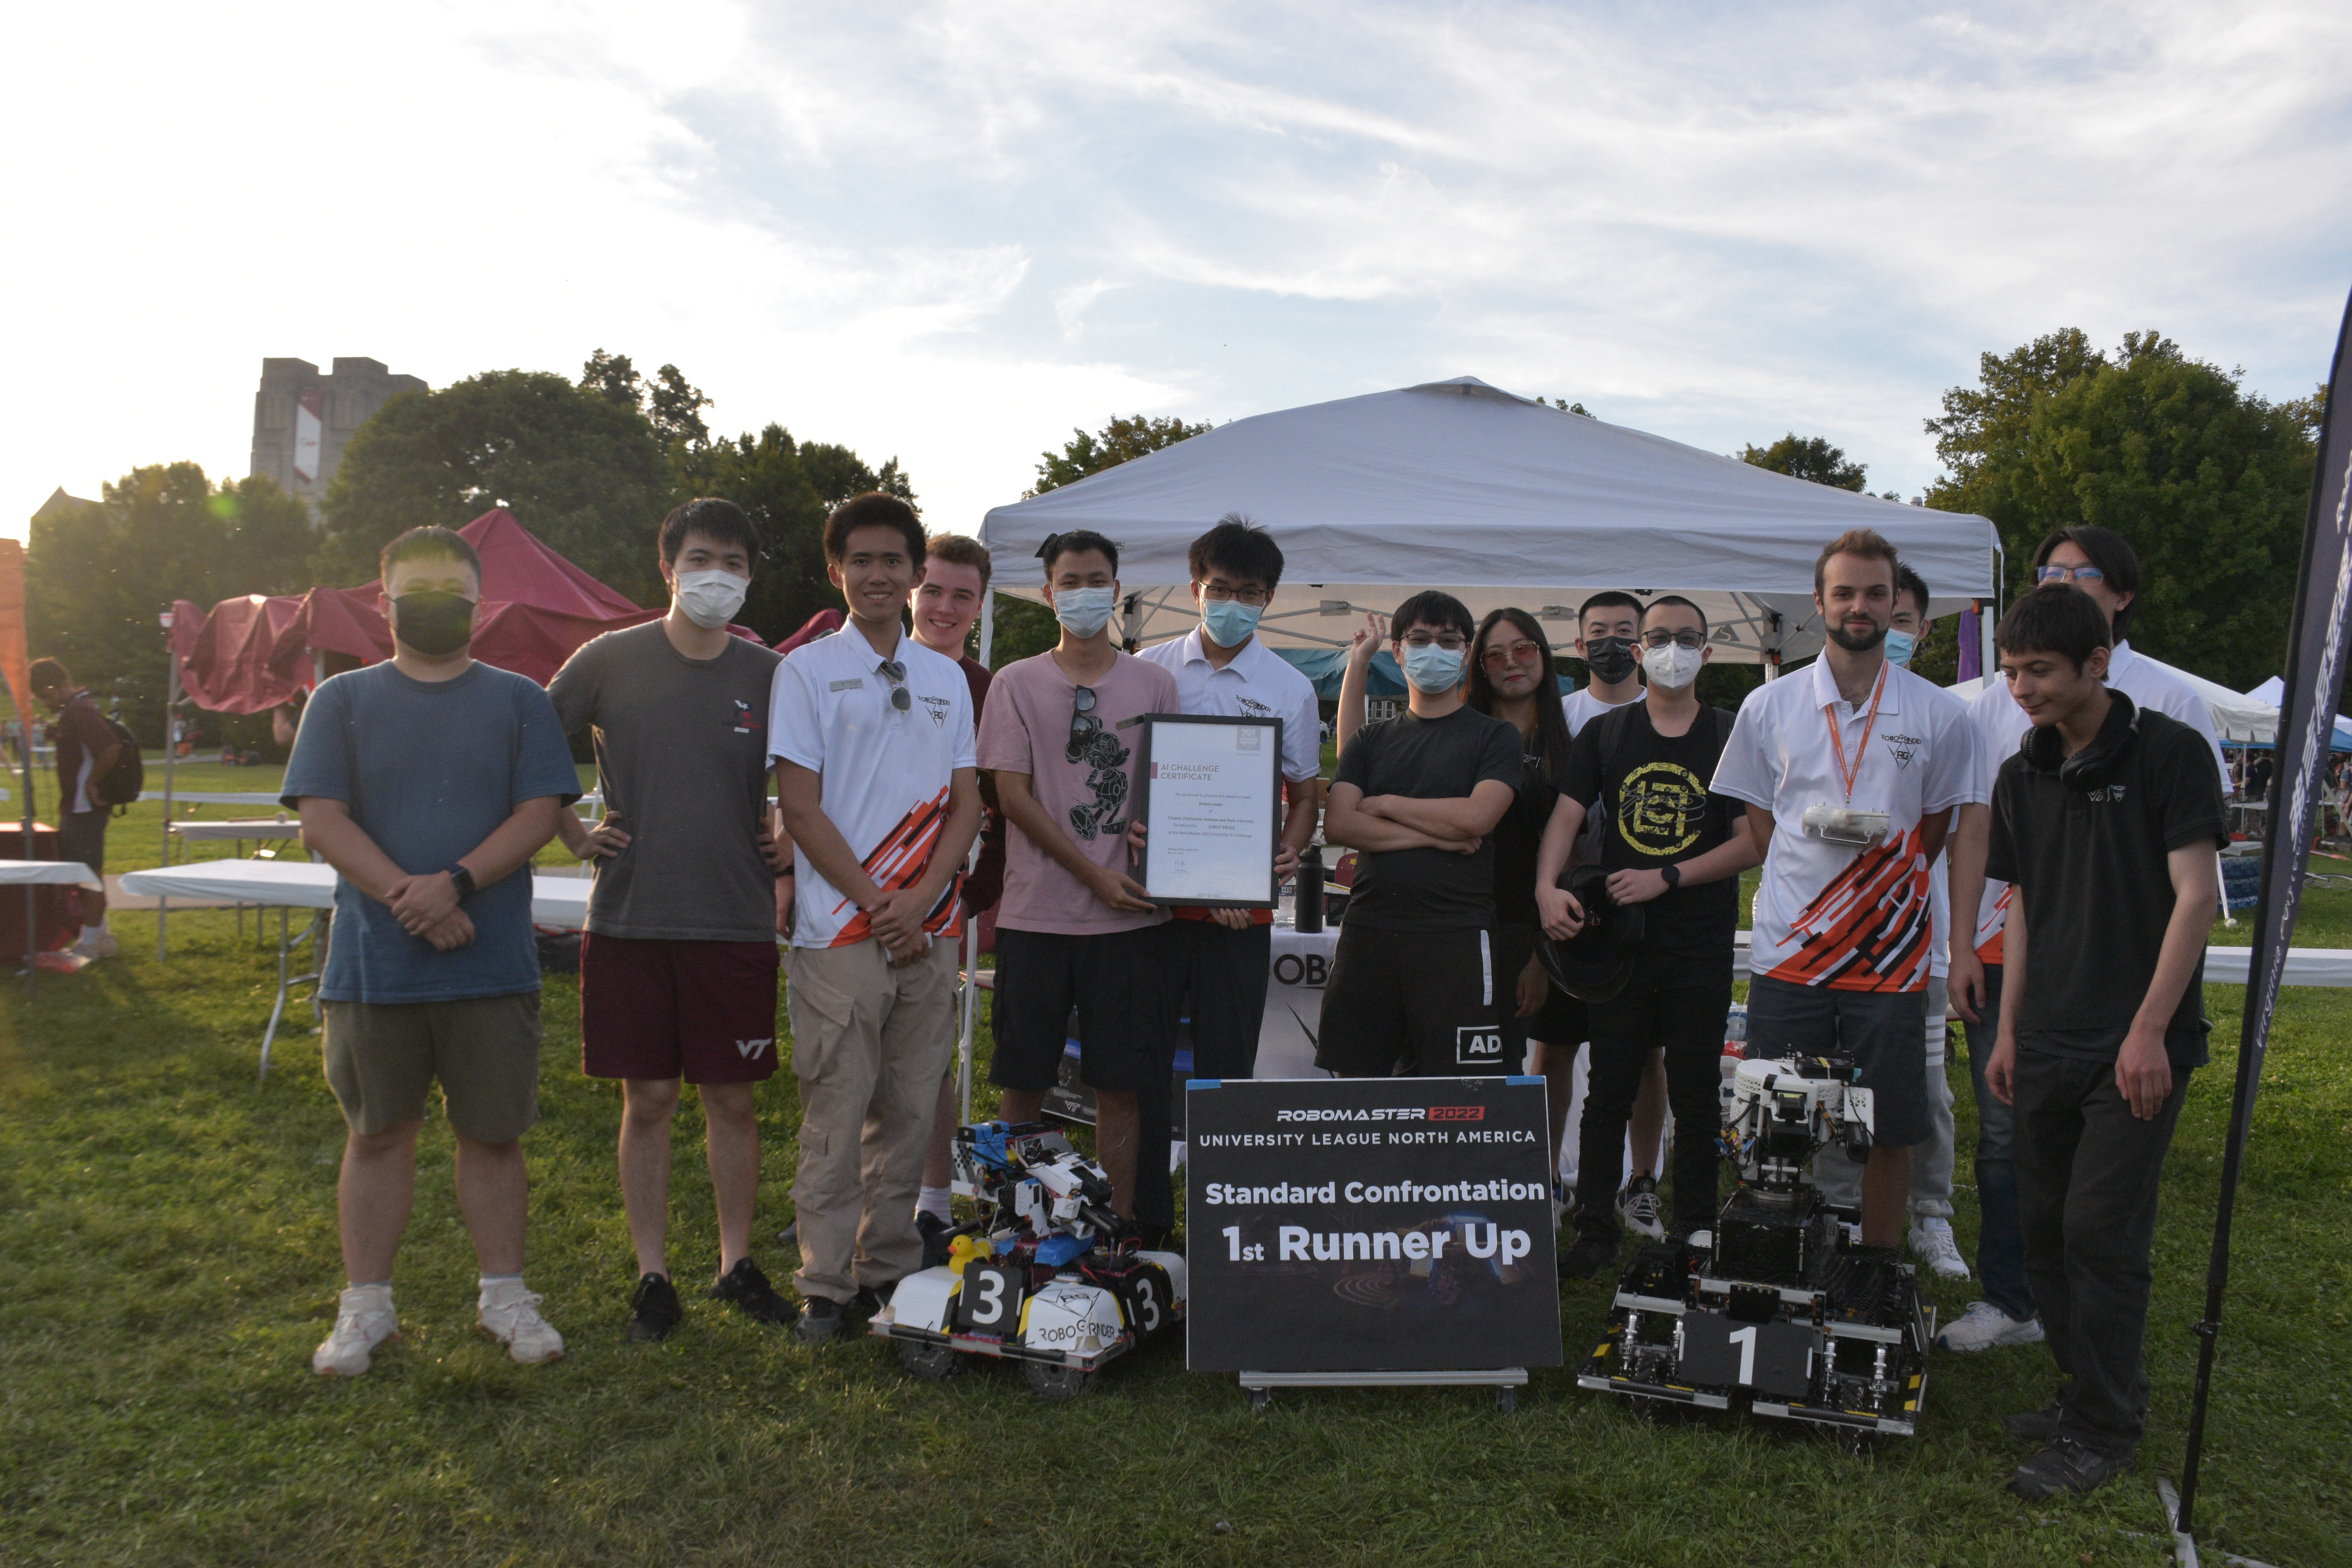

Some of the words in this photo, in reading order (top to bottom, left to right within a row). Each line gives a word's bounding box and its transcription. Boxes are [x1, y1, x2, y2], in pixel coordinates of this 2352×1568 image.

[735, 1037, 772, 1060] VT
[1277, 1108, 1425, 1122] ROBOMASTER
[1433, 1107, 1480, 1120] 2022
[1200, 1134, 1305, 1147] UNIVERSITY
[1312, 1133, 1381, 1145] LEAGUE
[1389, 1132, 1448, 1143] NORTH
[1456, 1130, 1536, 1143] AMERICA
[1205, 1182, 1336, 1204] Standard
[1345, 1179, 1545, 1203] Confrontation
[1222, 1225, 1265, 1261] 1st
[1279, 1225, 1450, 1261] Runner
[1465, 1223, 1532, 1266] Up
[972, 1270, 1005, 1324] 3
[1136, 1278, 1160, 1332] 3
[1729, 1326, 1757, 1385] 1
